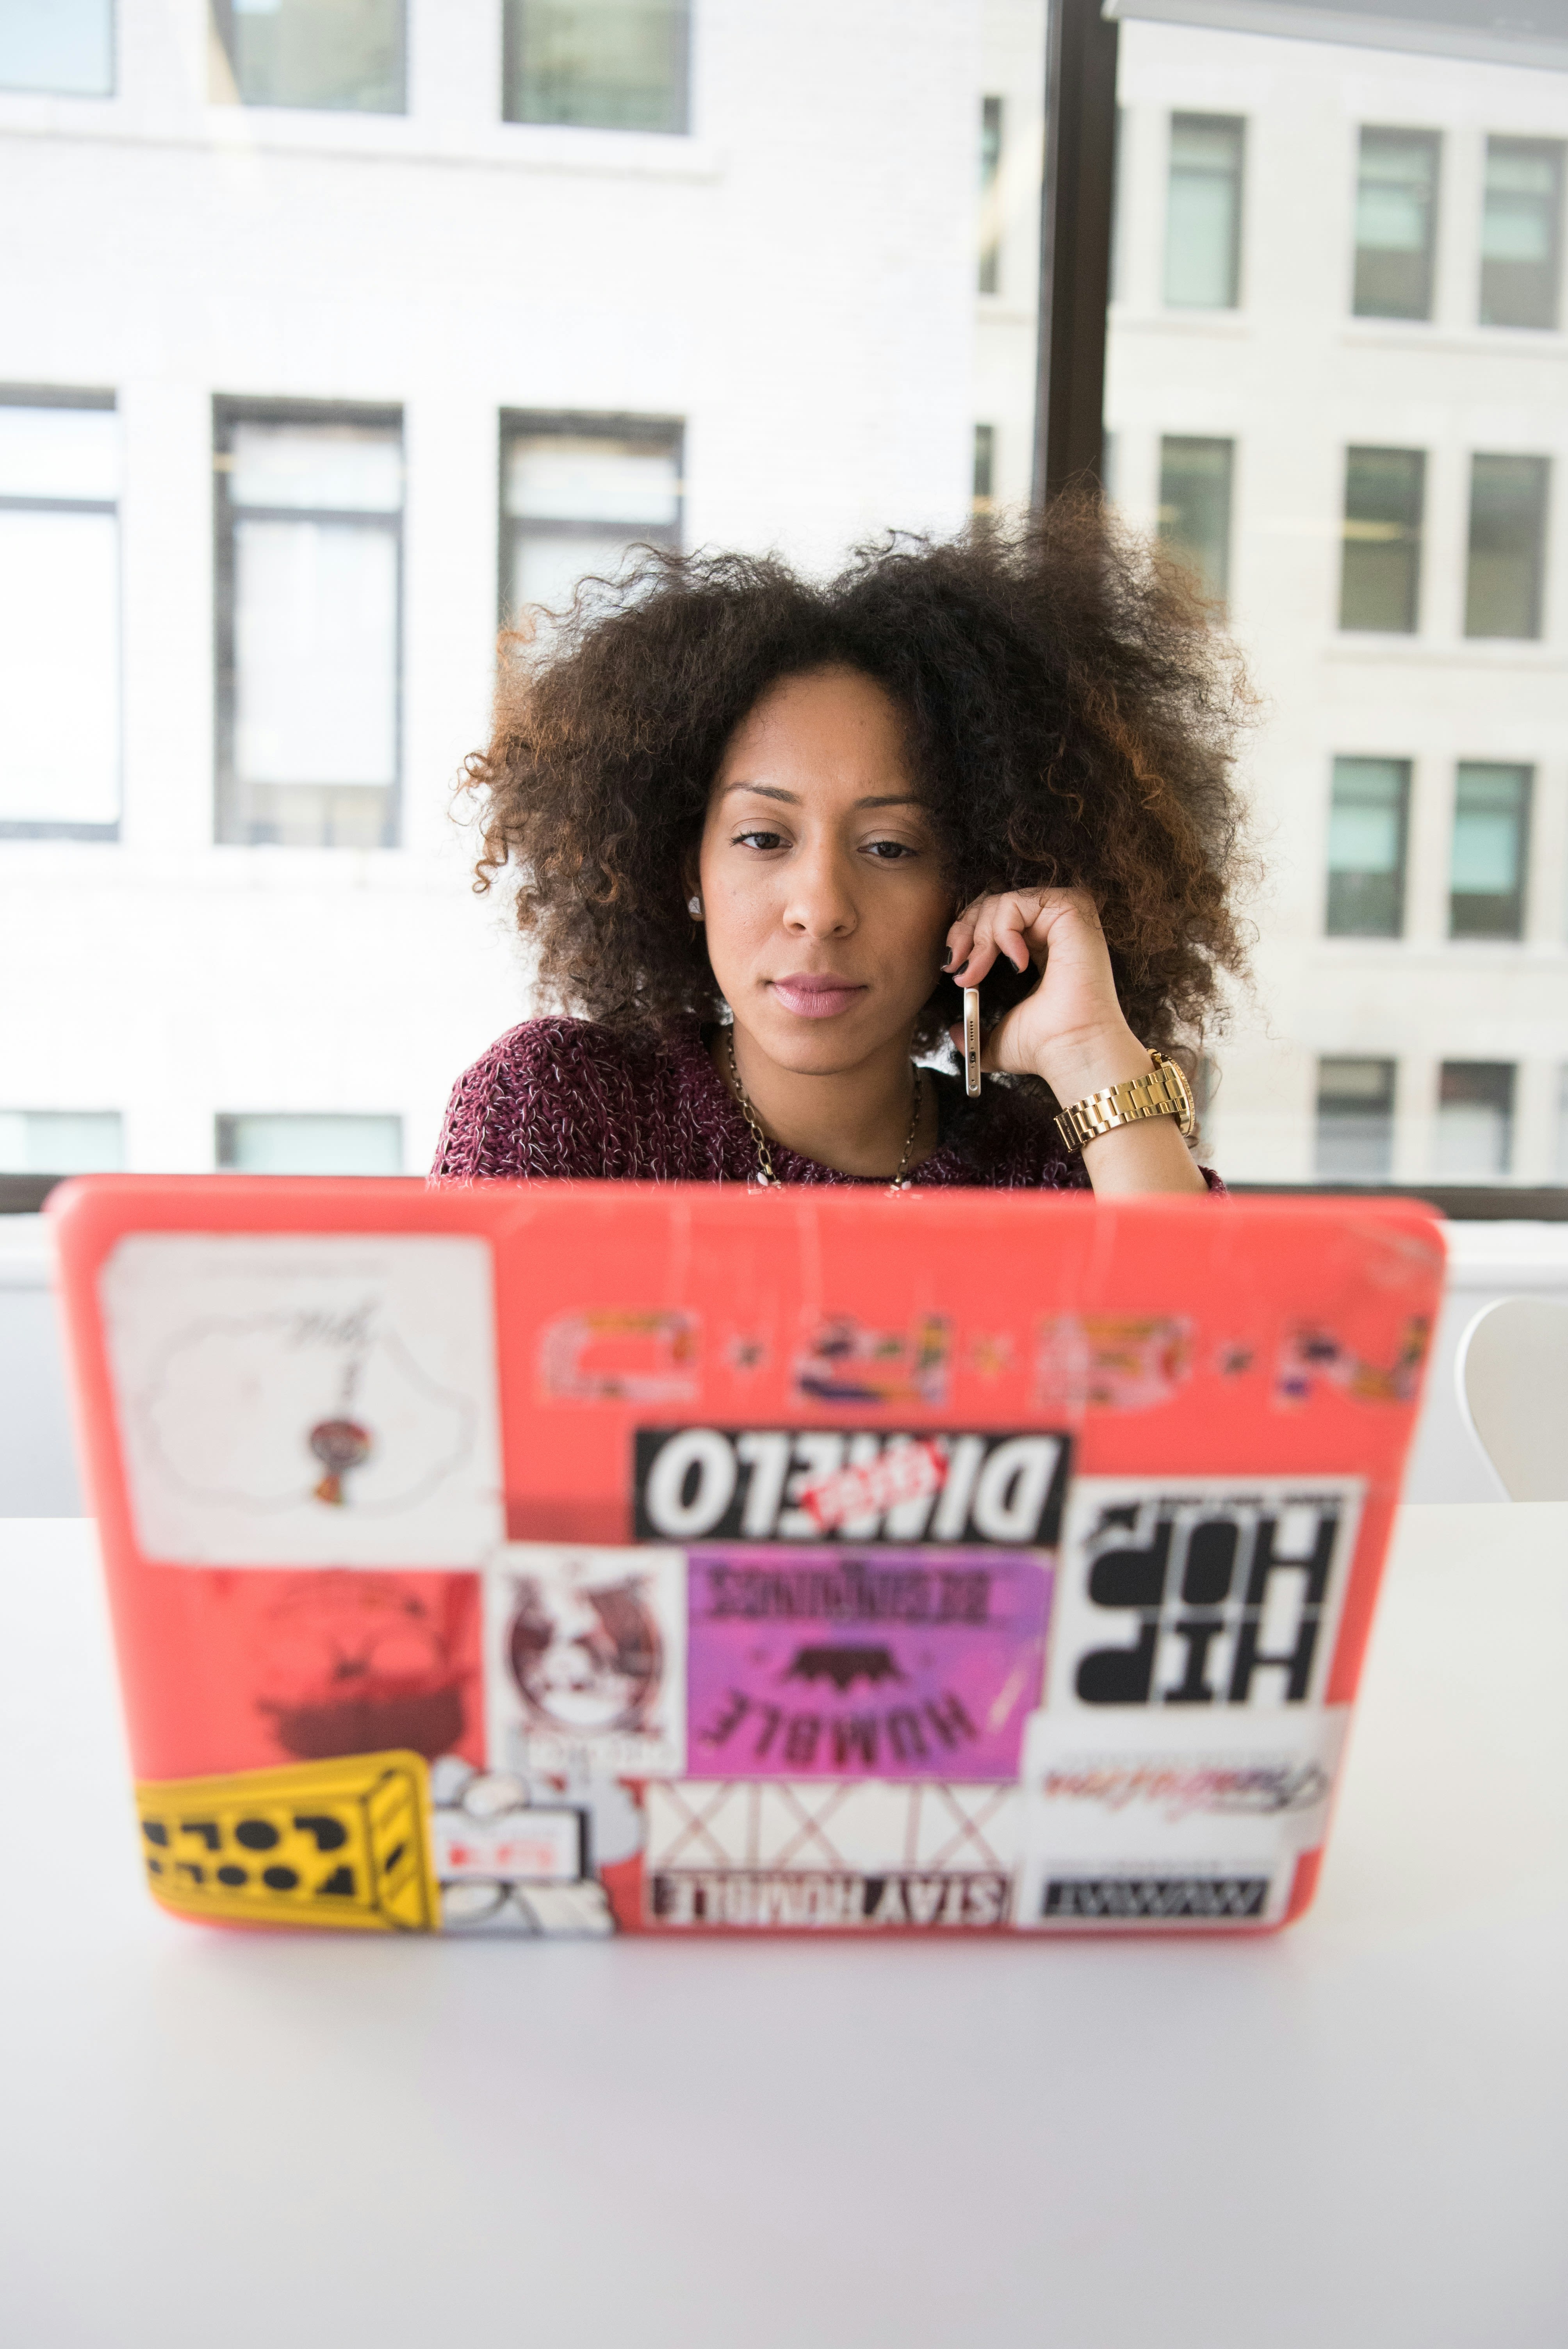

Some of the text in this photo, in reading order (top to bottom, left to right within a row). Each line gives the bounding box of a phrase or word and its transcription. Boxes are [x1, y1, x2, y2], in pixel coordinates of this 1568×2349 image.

[1085, 1519, 1338, 1609] HOP
[1074, 1621, 1322, 1706] HIP
[698, 1687, 981, 1772] HUMBLE
[667, 1878, 1005, 1924] STAY HUMBLE
